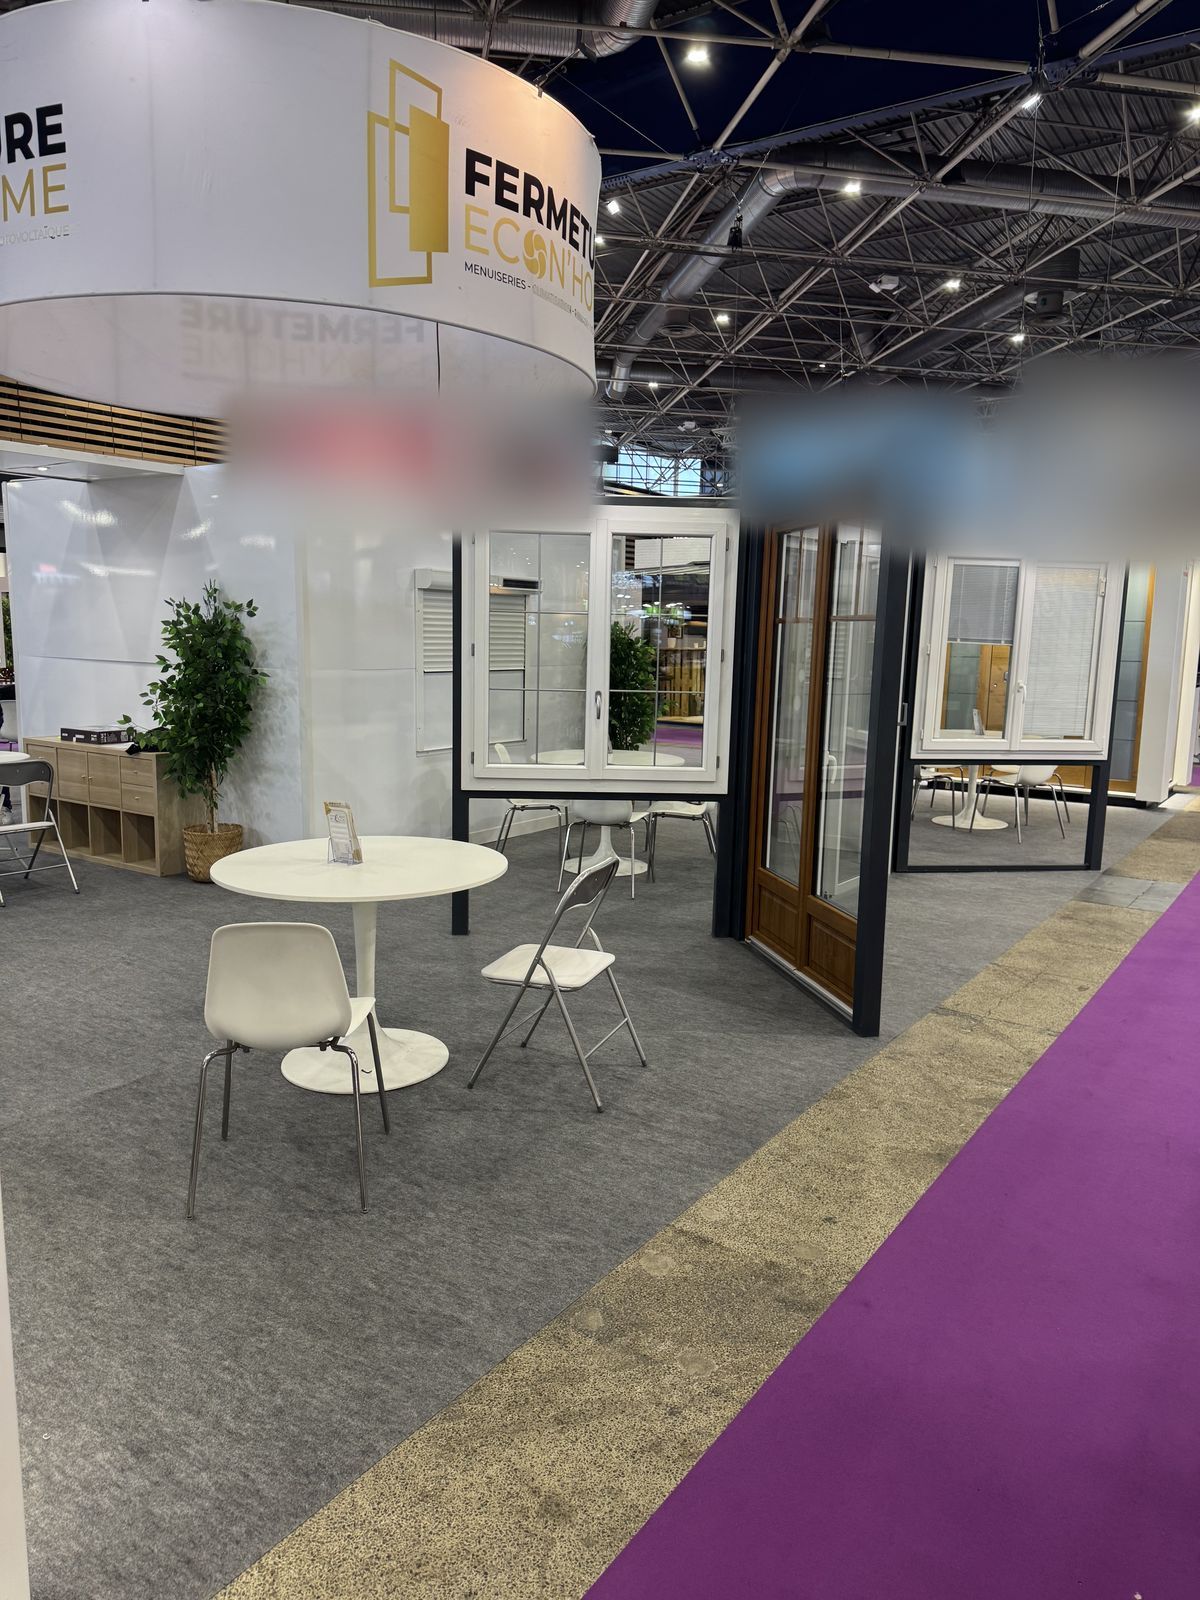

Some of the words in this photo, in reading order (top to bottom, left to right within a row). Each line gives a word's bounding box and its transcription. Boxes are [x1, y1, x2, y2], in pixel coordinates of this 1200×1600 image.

[0, 103, 66, 164] RE
[465, 147, 595, 271] FERMETU
[464, 260, 526, 290] MENUISERIES
